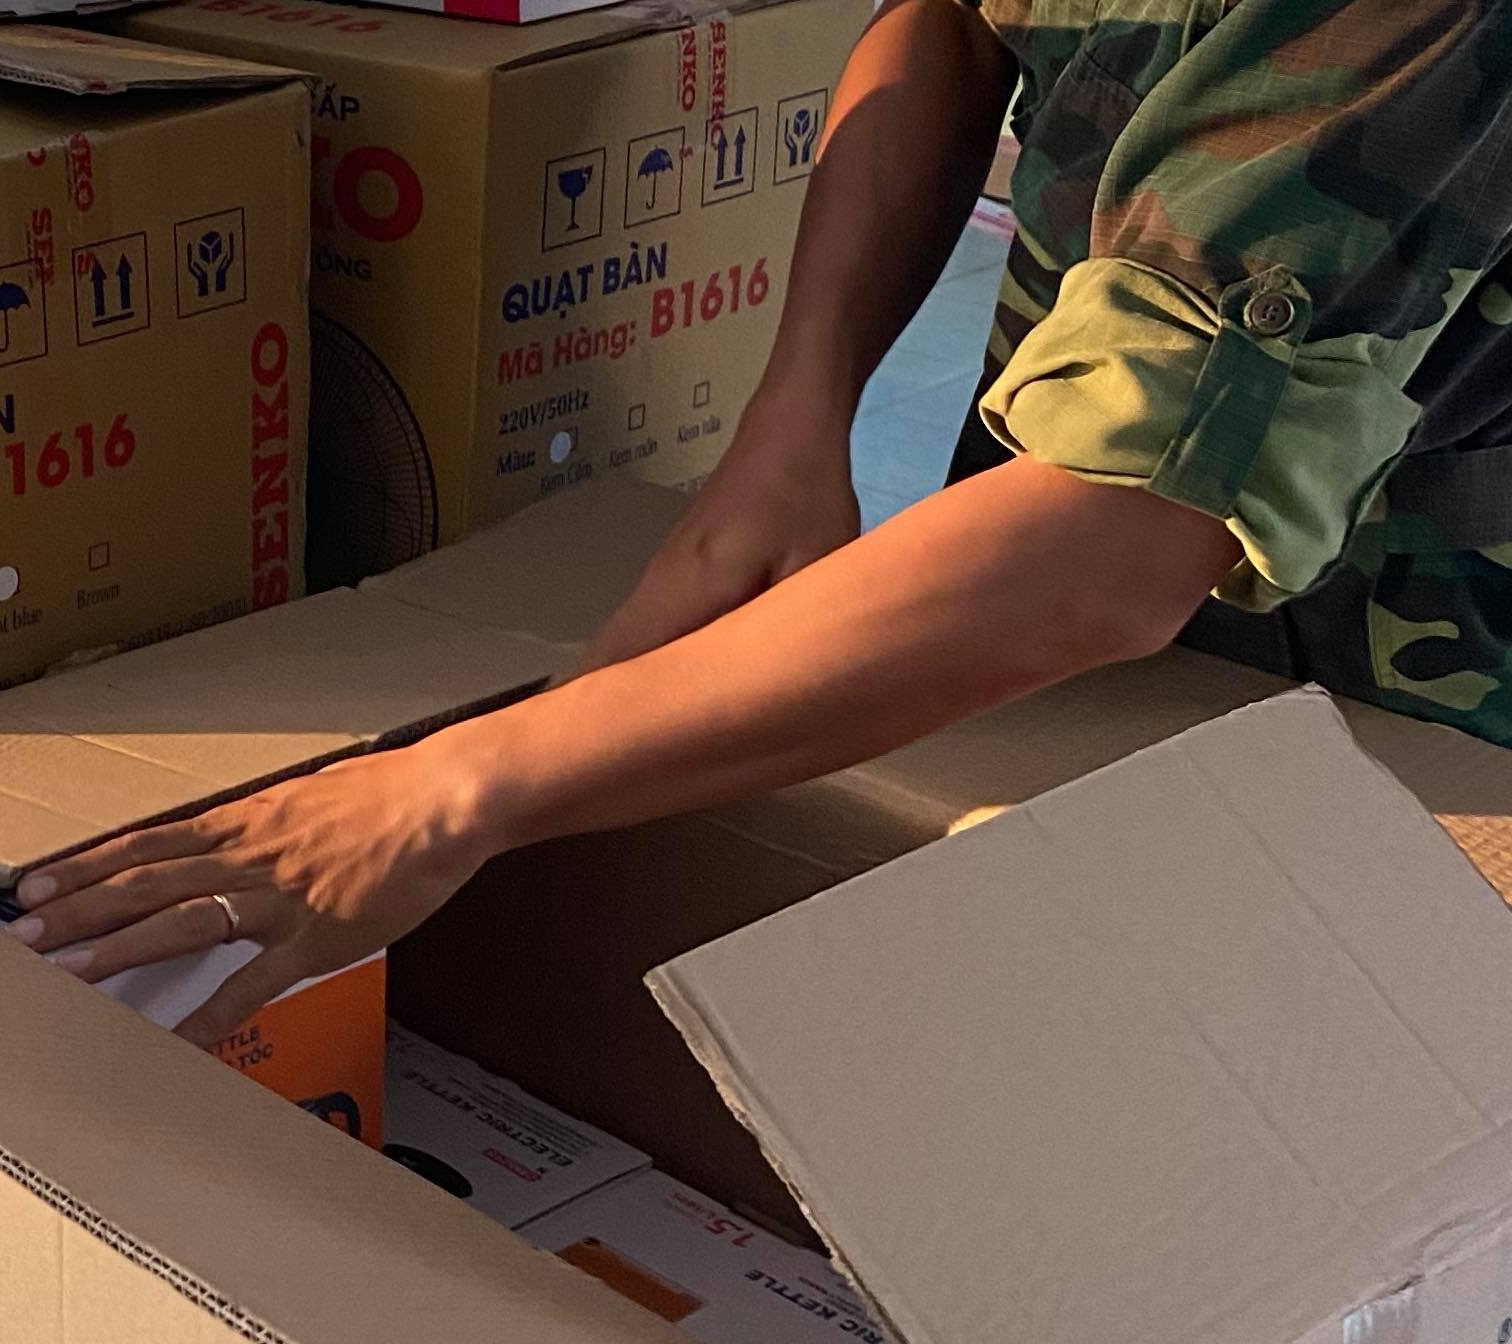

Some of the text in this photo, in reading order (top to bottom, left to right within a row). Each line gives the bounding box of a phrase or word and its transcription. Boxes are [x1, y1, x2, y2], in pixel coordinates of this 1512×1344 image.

[502, 242, 668, 322] QUẠT BÀN
[498, 258, 770, 384] Mã Hàng: B1616
[498, 391, 589, 436] 220V/50Hz
[251, 323, 288, 610] SENKO
[8, 605, 42, 631] blue
[76, 583, 119, 609] Brown
